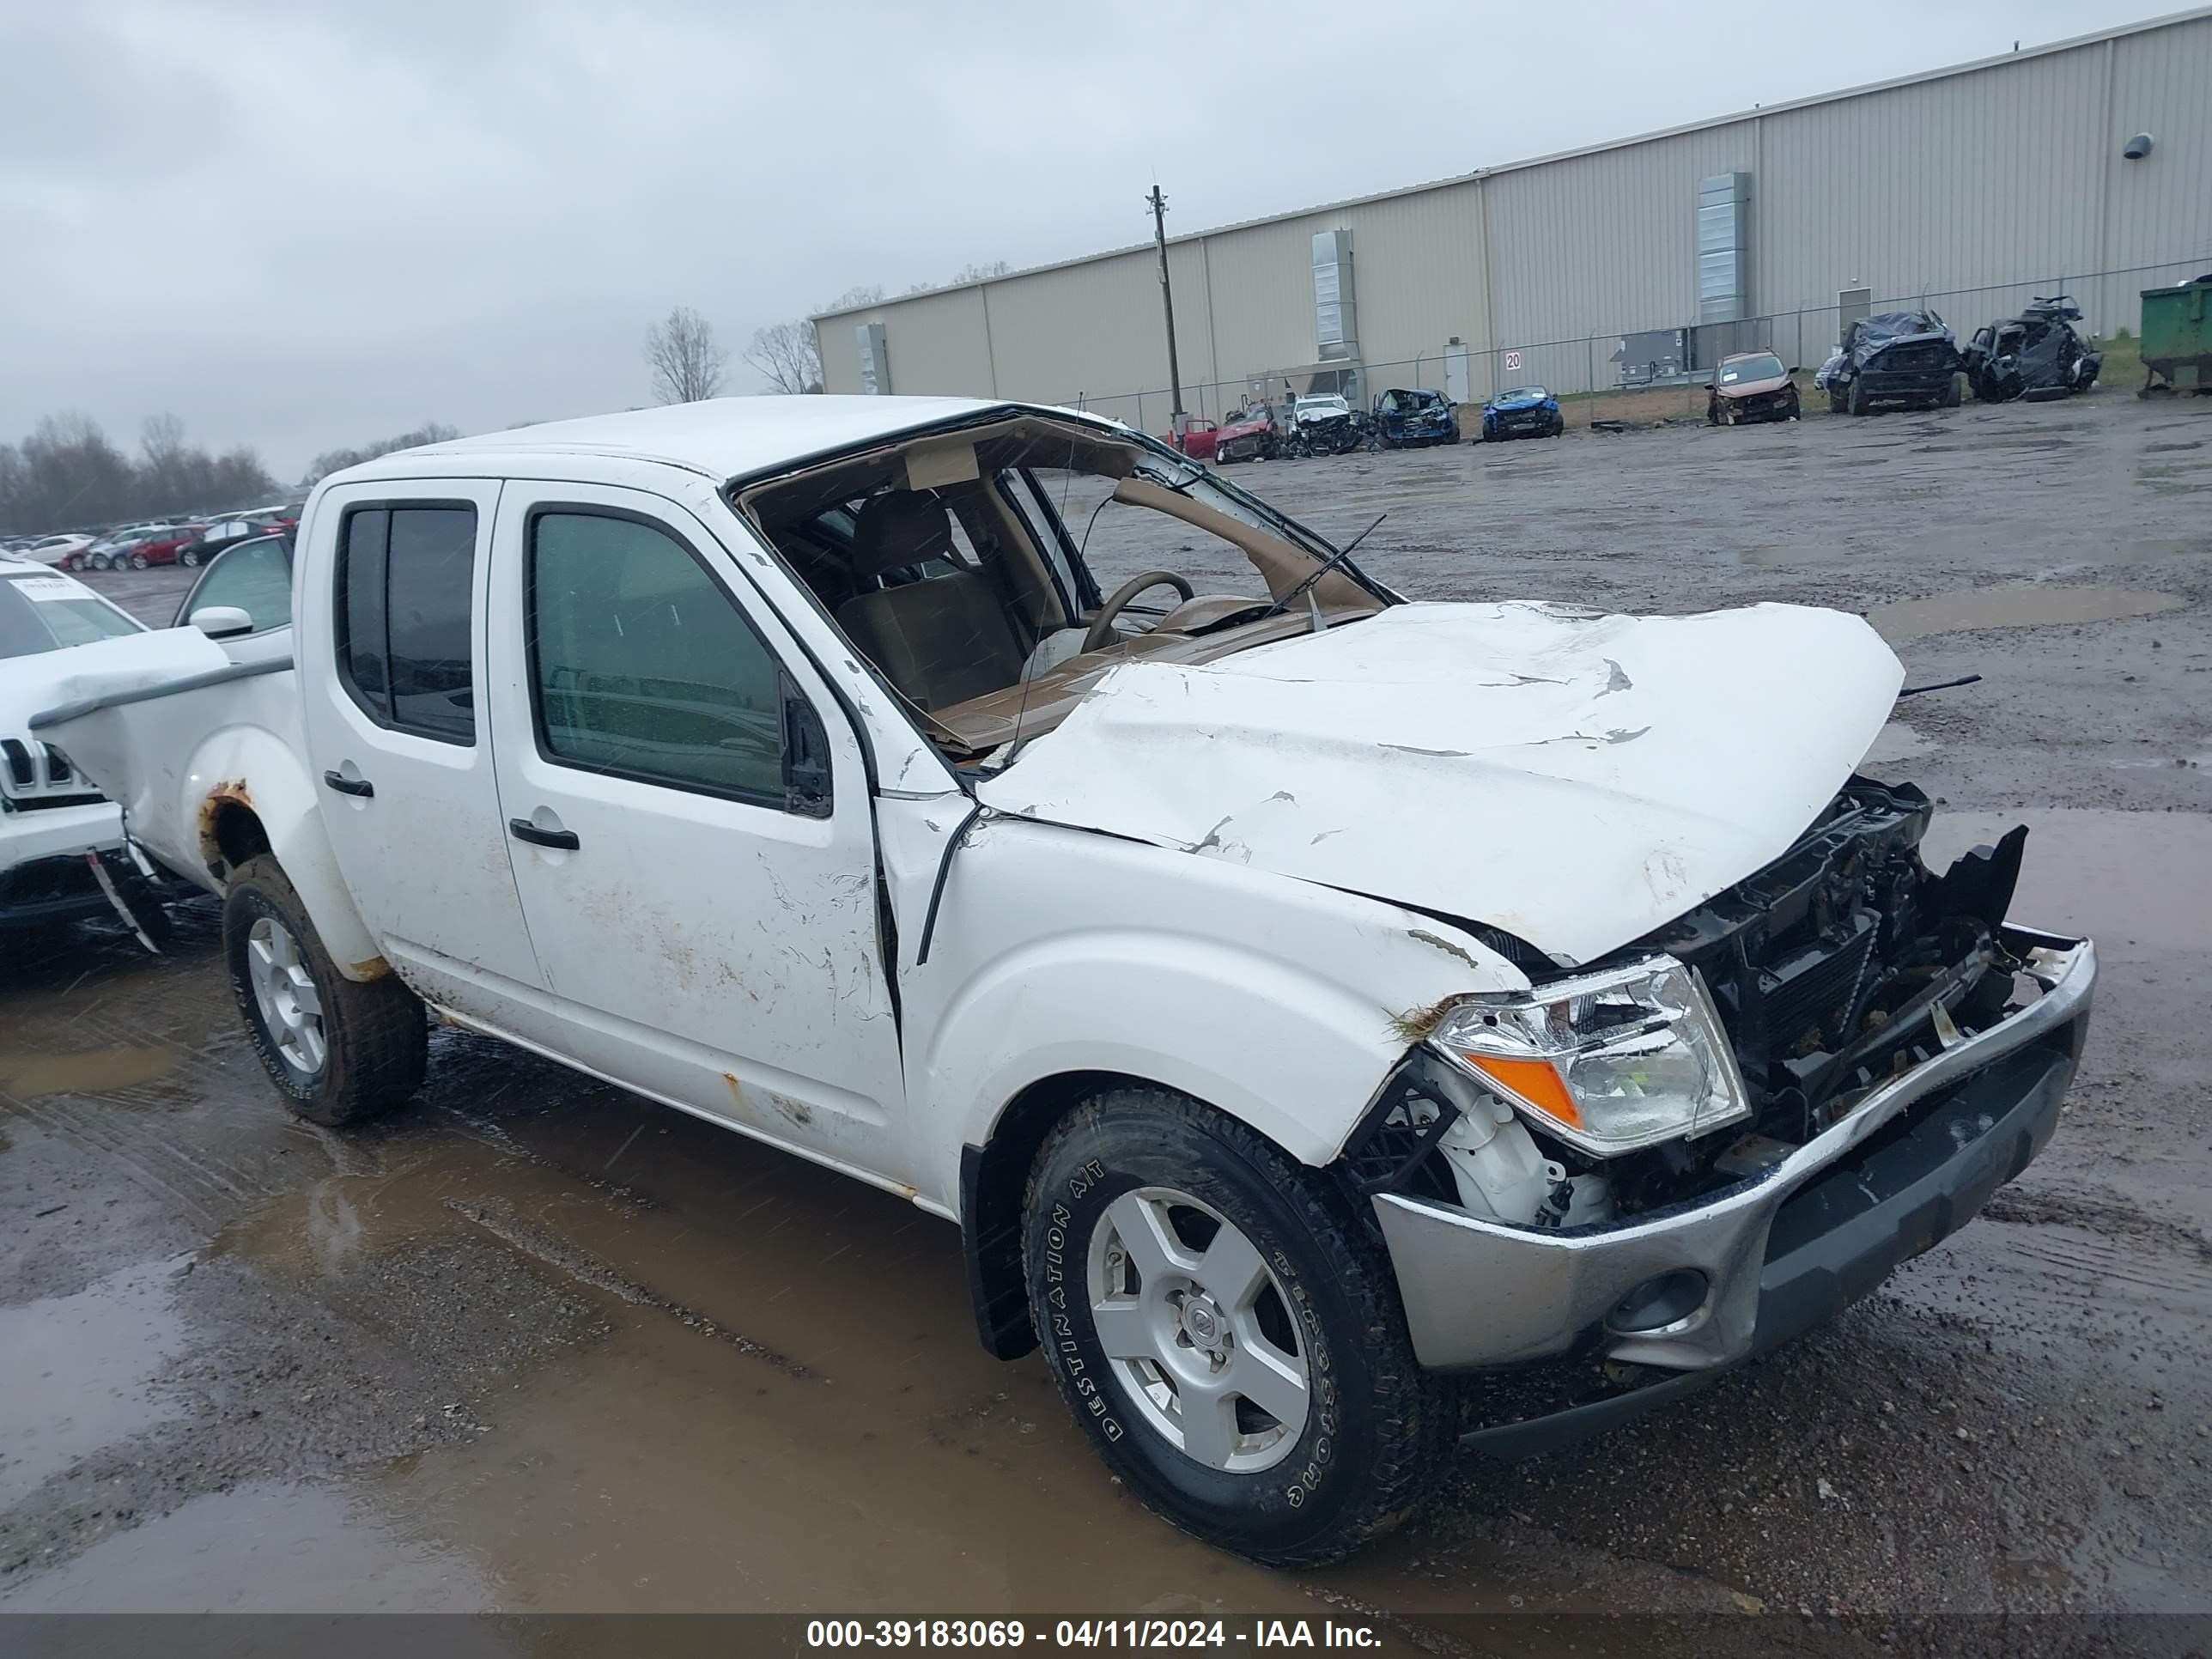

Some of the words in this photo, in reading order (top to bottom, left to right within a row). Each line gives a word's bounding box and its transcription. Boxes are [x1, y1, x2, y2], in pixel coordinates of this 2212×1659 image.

[1507, 354, 1520, 368] 20
[1070, 1159, 1105, 1199] A/T
[1047, 1203, 1124, 1443] DESTINATION
